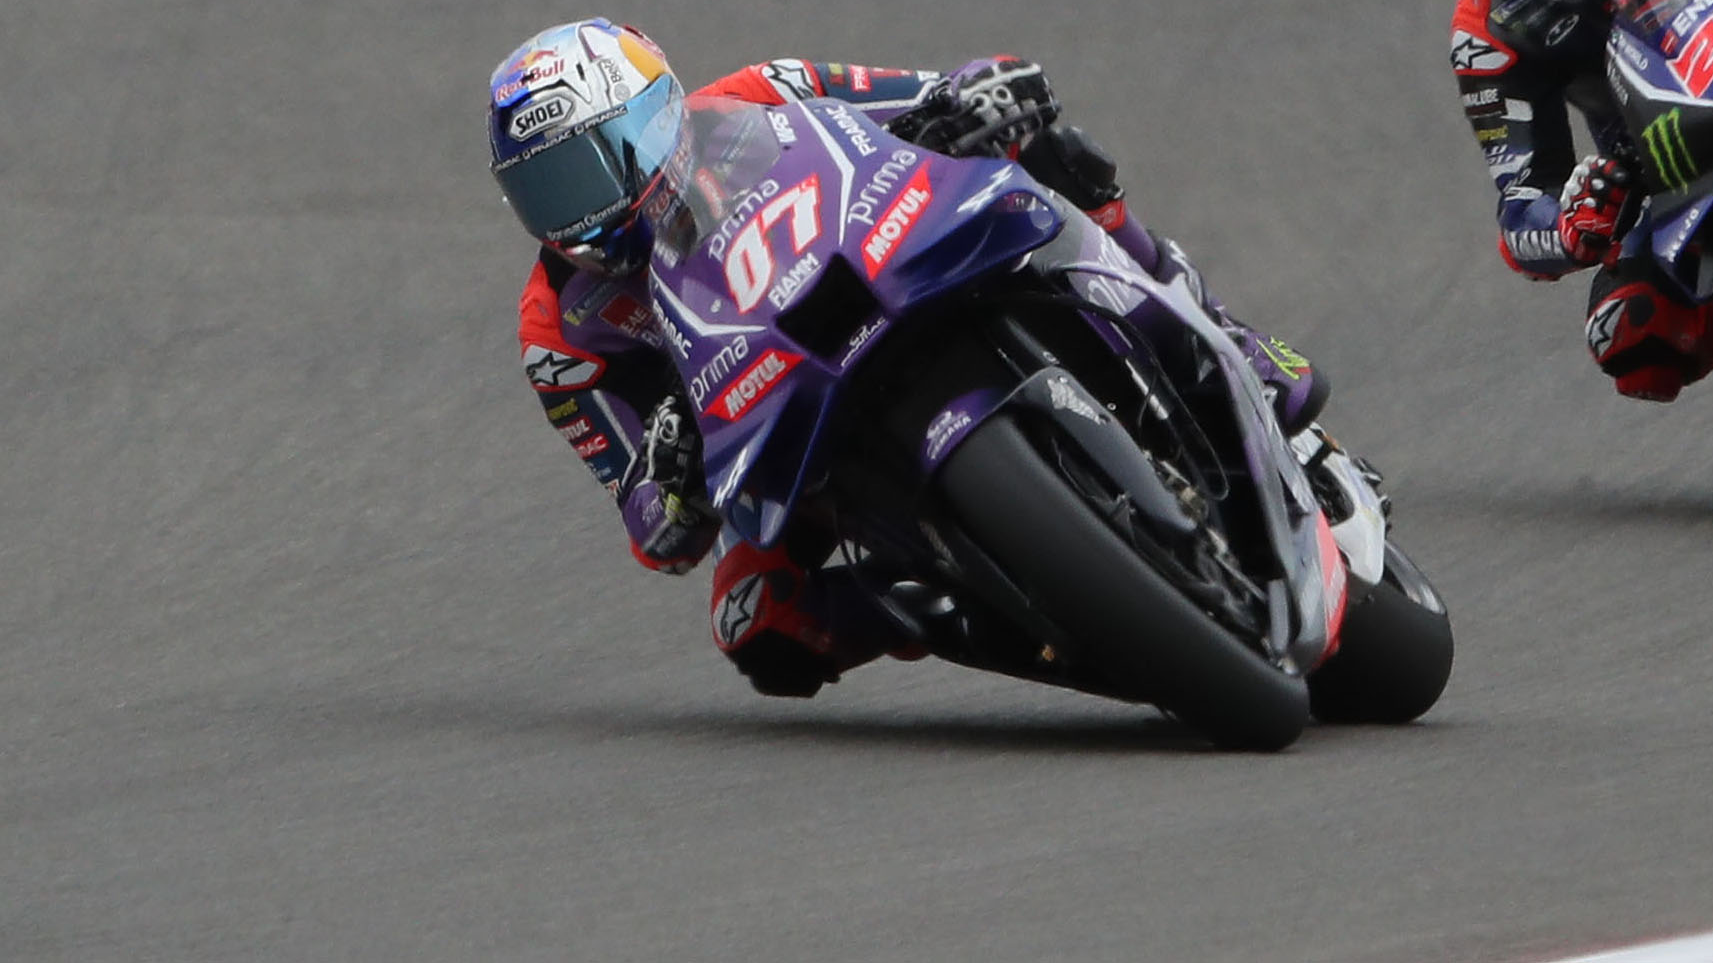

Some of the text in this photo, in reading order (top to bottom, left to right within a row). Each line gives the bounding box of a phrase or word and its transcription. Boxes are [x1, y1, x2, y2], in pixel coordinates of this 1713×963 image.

[529, 59, 565, 83] Bull
[515, 101, 563, 136] SHOEI
[826, 104, 878, 157] PRAMAC
[708, 179, 780, 262] prima
[847, 149, 918, 226] prima
[724, 172, 822, 316] 07
[865, 186, 928, 264] MOTUL
[767, 252, 820, 307] FIAMM
[689, 335, 750, 412] prima
[723, 352, 787, 419] MOTUL
